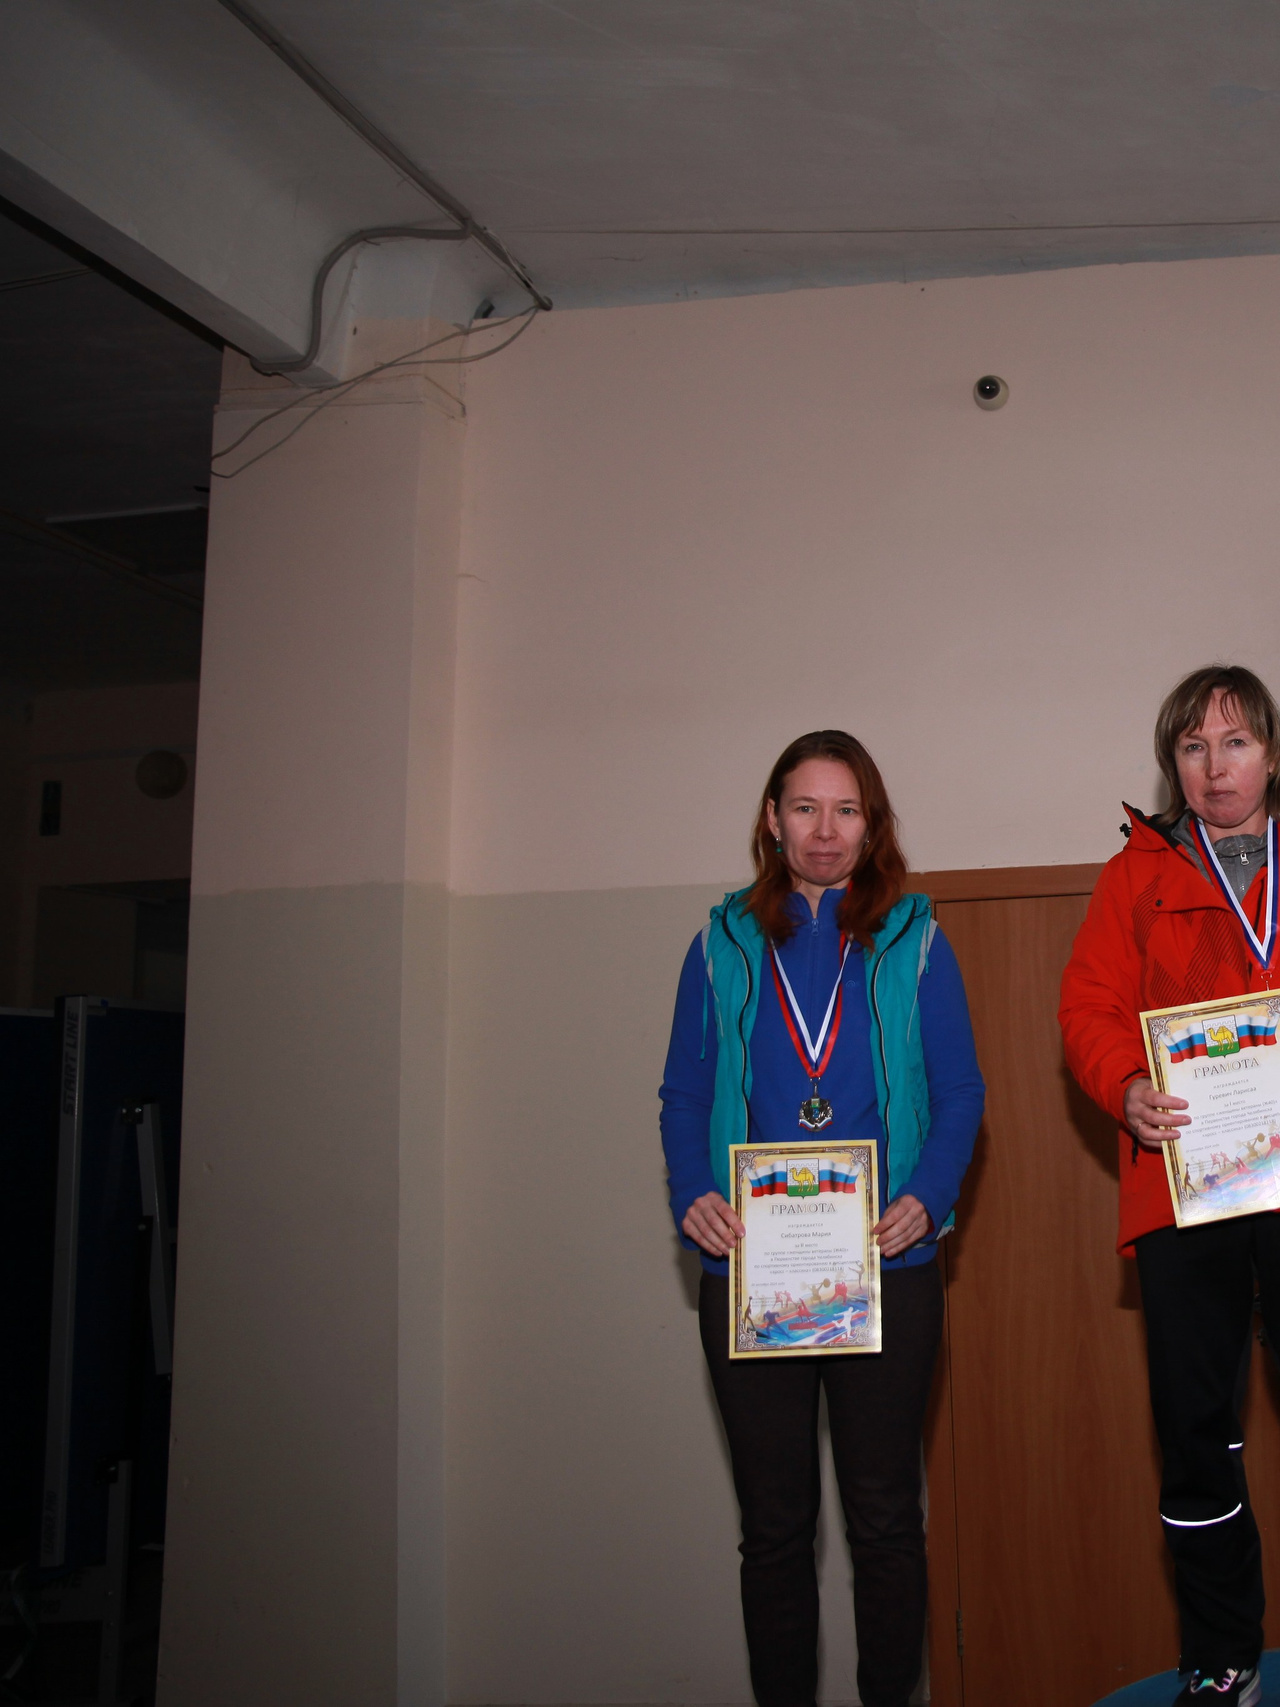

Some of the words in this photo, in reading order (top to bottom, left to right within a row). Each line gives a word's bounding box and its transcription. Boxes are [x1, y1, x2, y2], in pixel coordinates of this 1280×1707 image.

[66, 1010, 78, 1048] LINE
[1193, 1058, 1260, 1078] ГРАМОТА
[63, 1052, 75, 1116] START
[1209, 1092, 1232, 1101] Гуревич
[771, 1202, 836, 1215] ГРАМОТА
